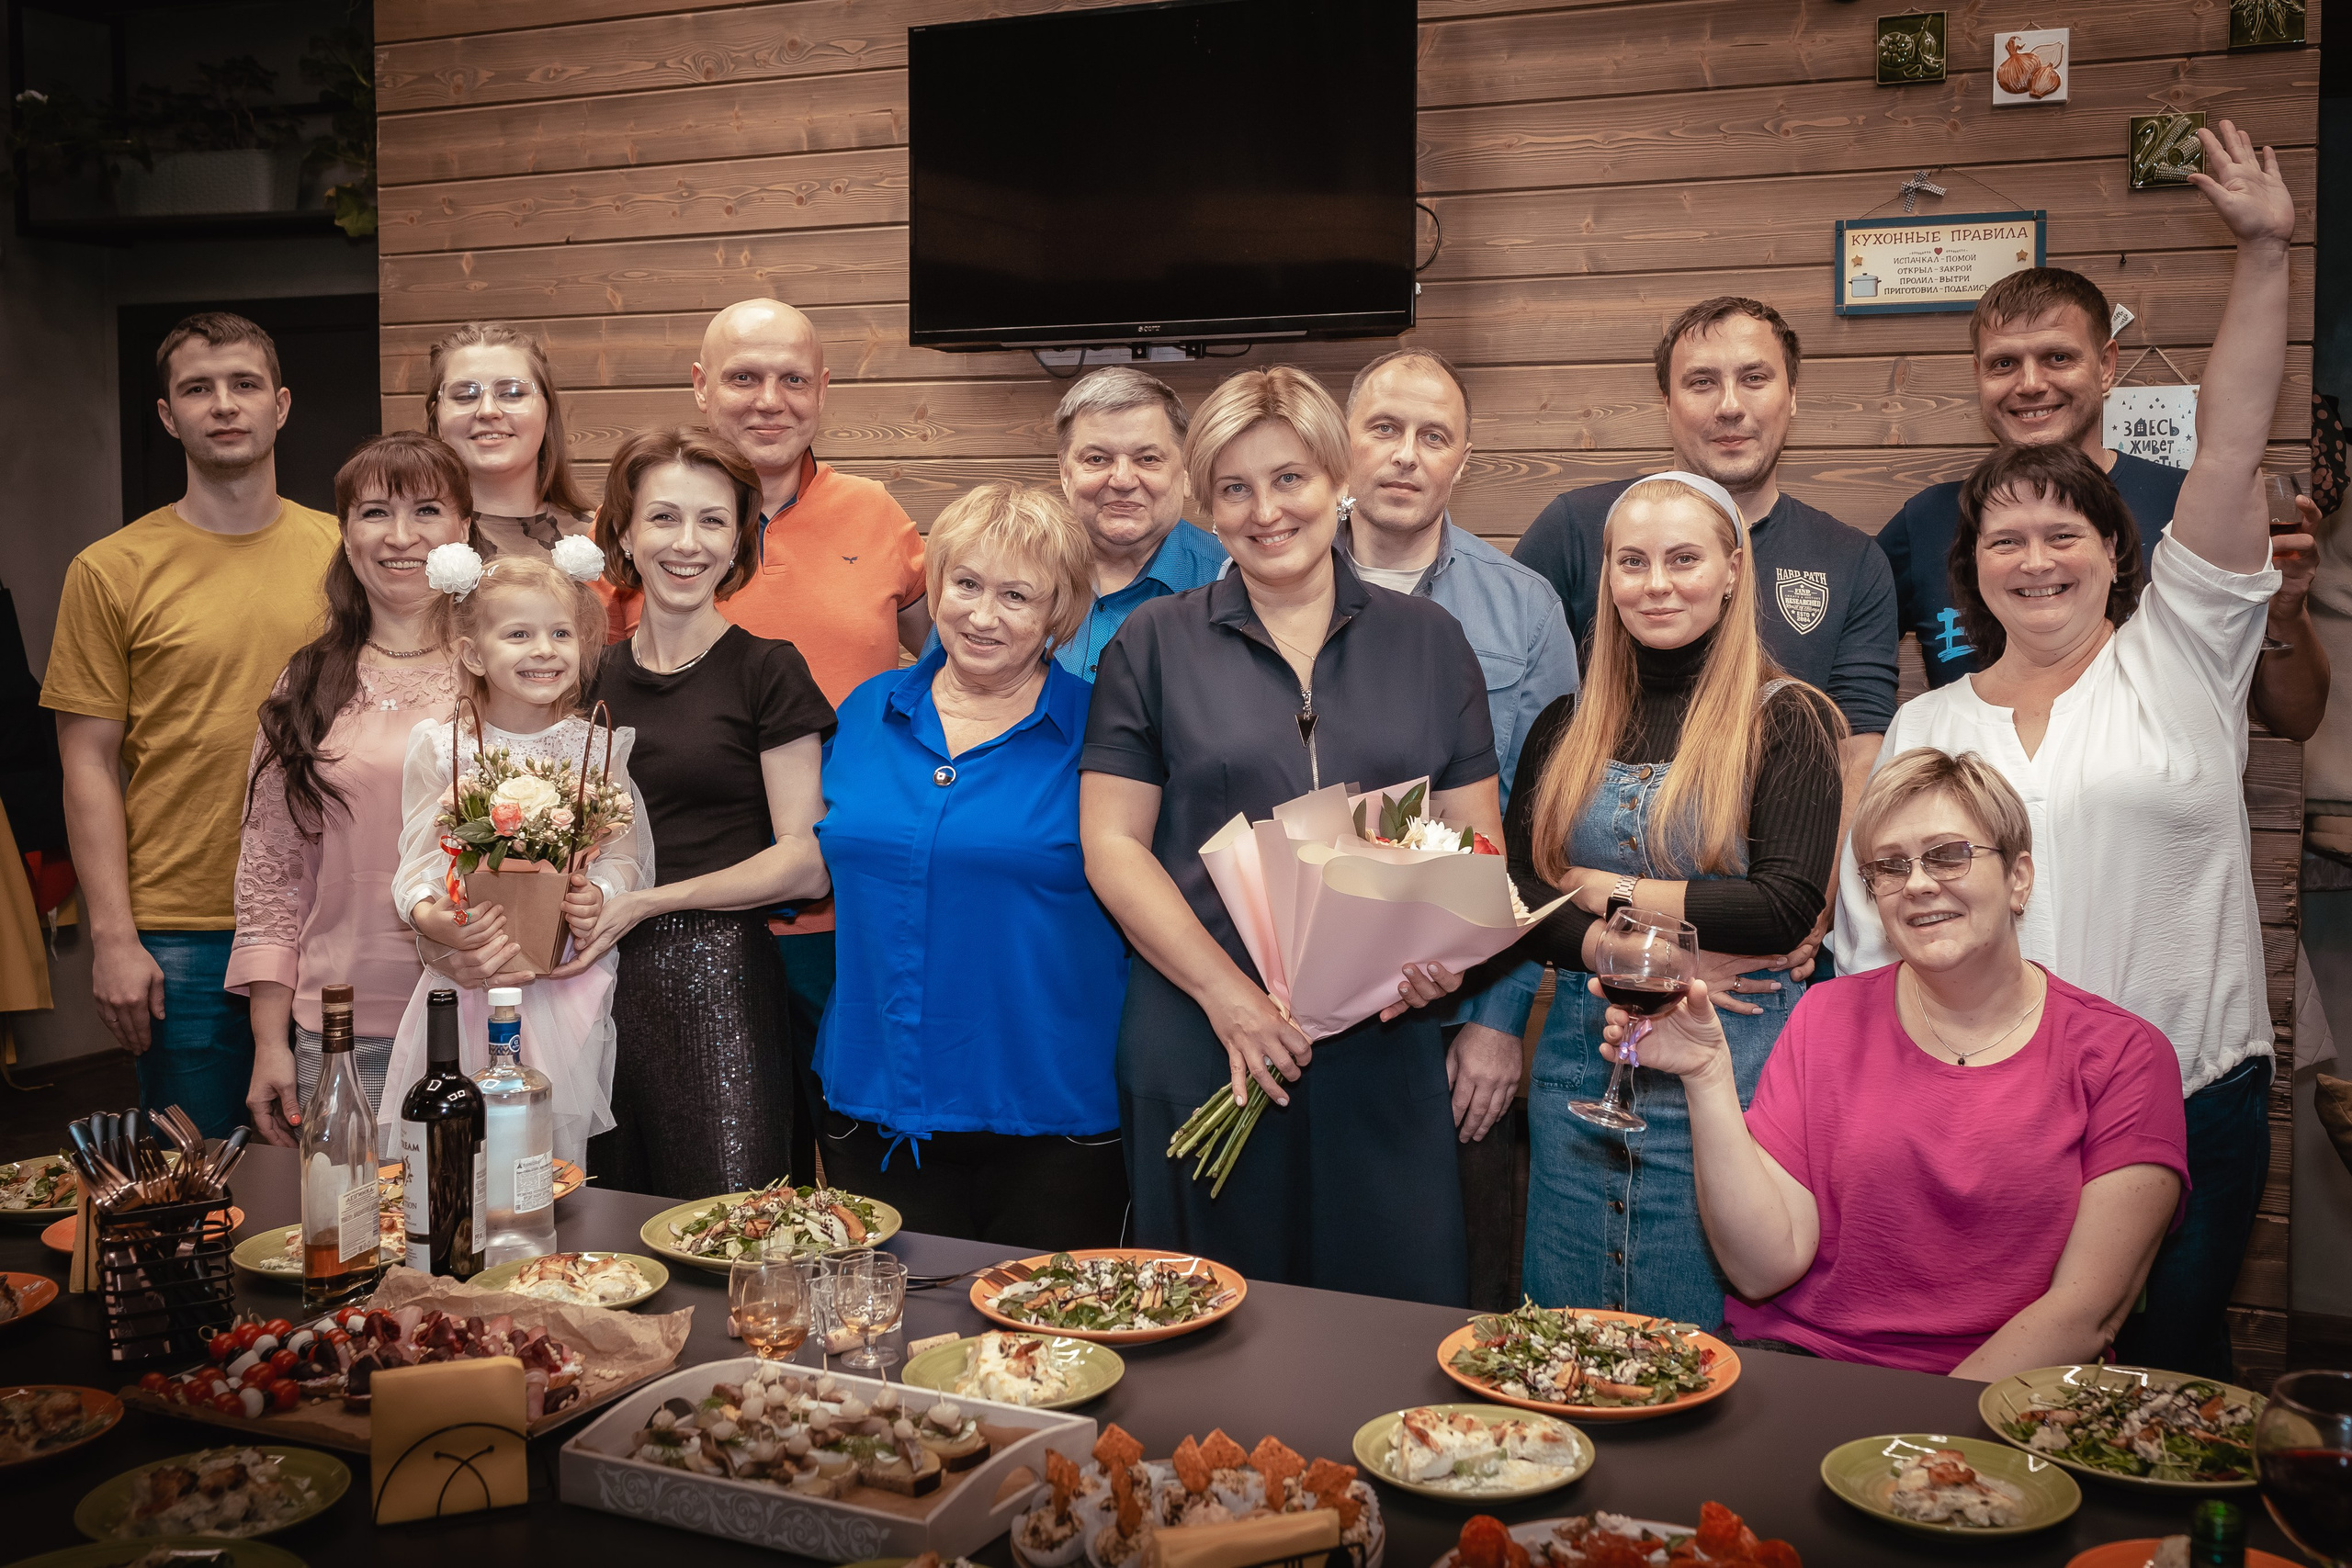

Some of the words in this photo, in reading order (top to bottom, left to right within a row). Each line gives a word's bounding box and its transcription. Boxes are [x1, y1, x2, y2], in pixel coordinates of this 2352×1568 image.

[1851, 231, 1941, 246] КУХОННЫЕ
[1951, 227, 2029, 242] ПРАВИЛА
[2123, 417, 2180, 437] ЗДЕСЬ
[1776, 568, 1801, 581] HARD
[1804, 571, 1827, 585] PATH
